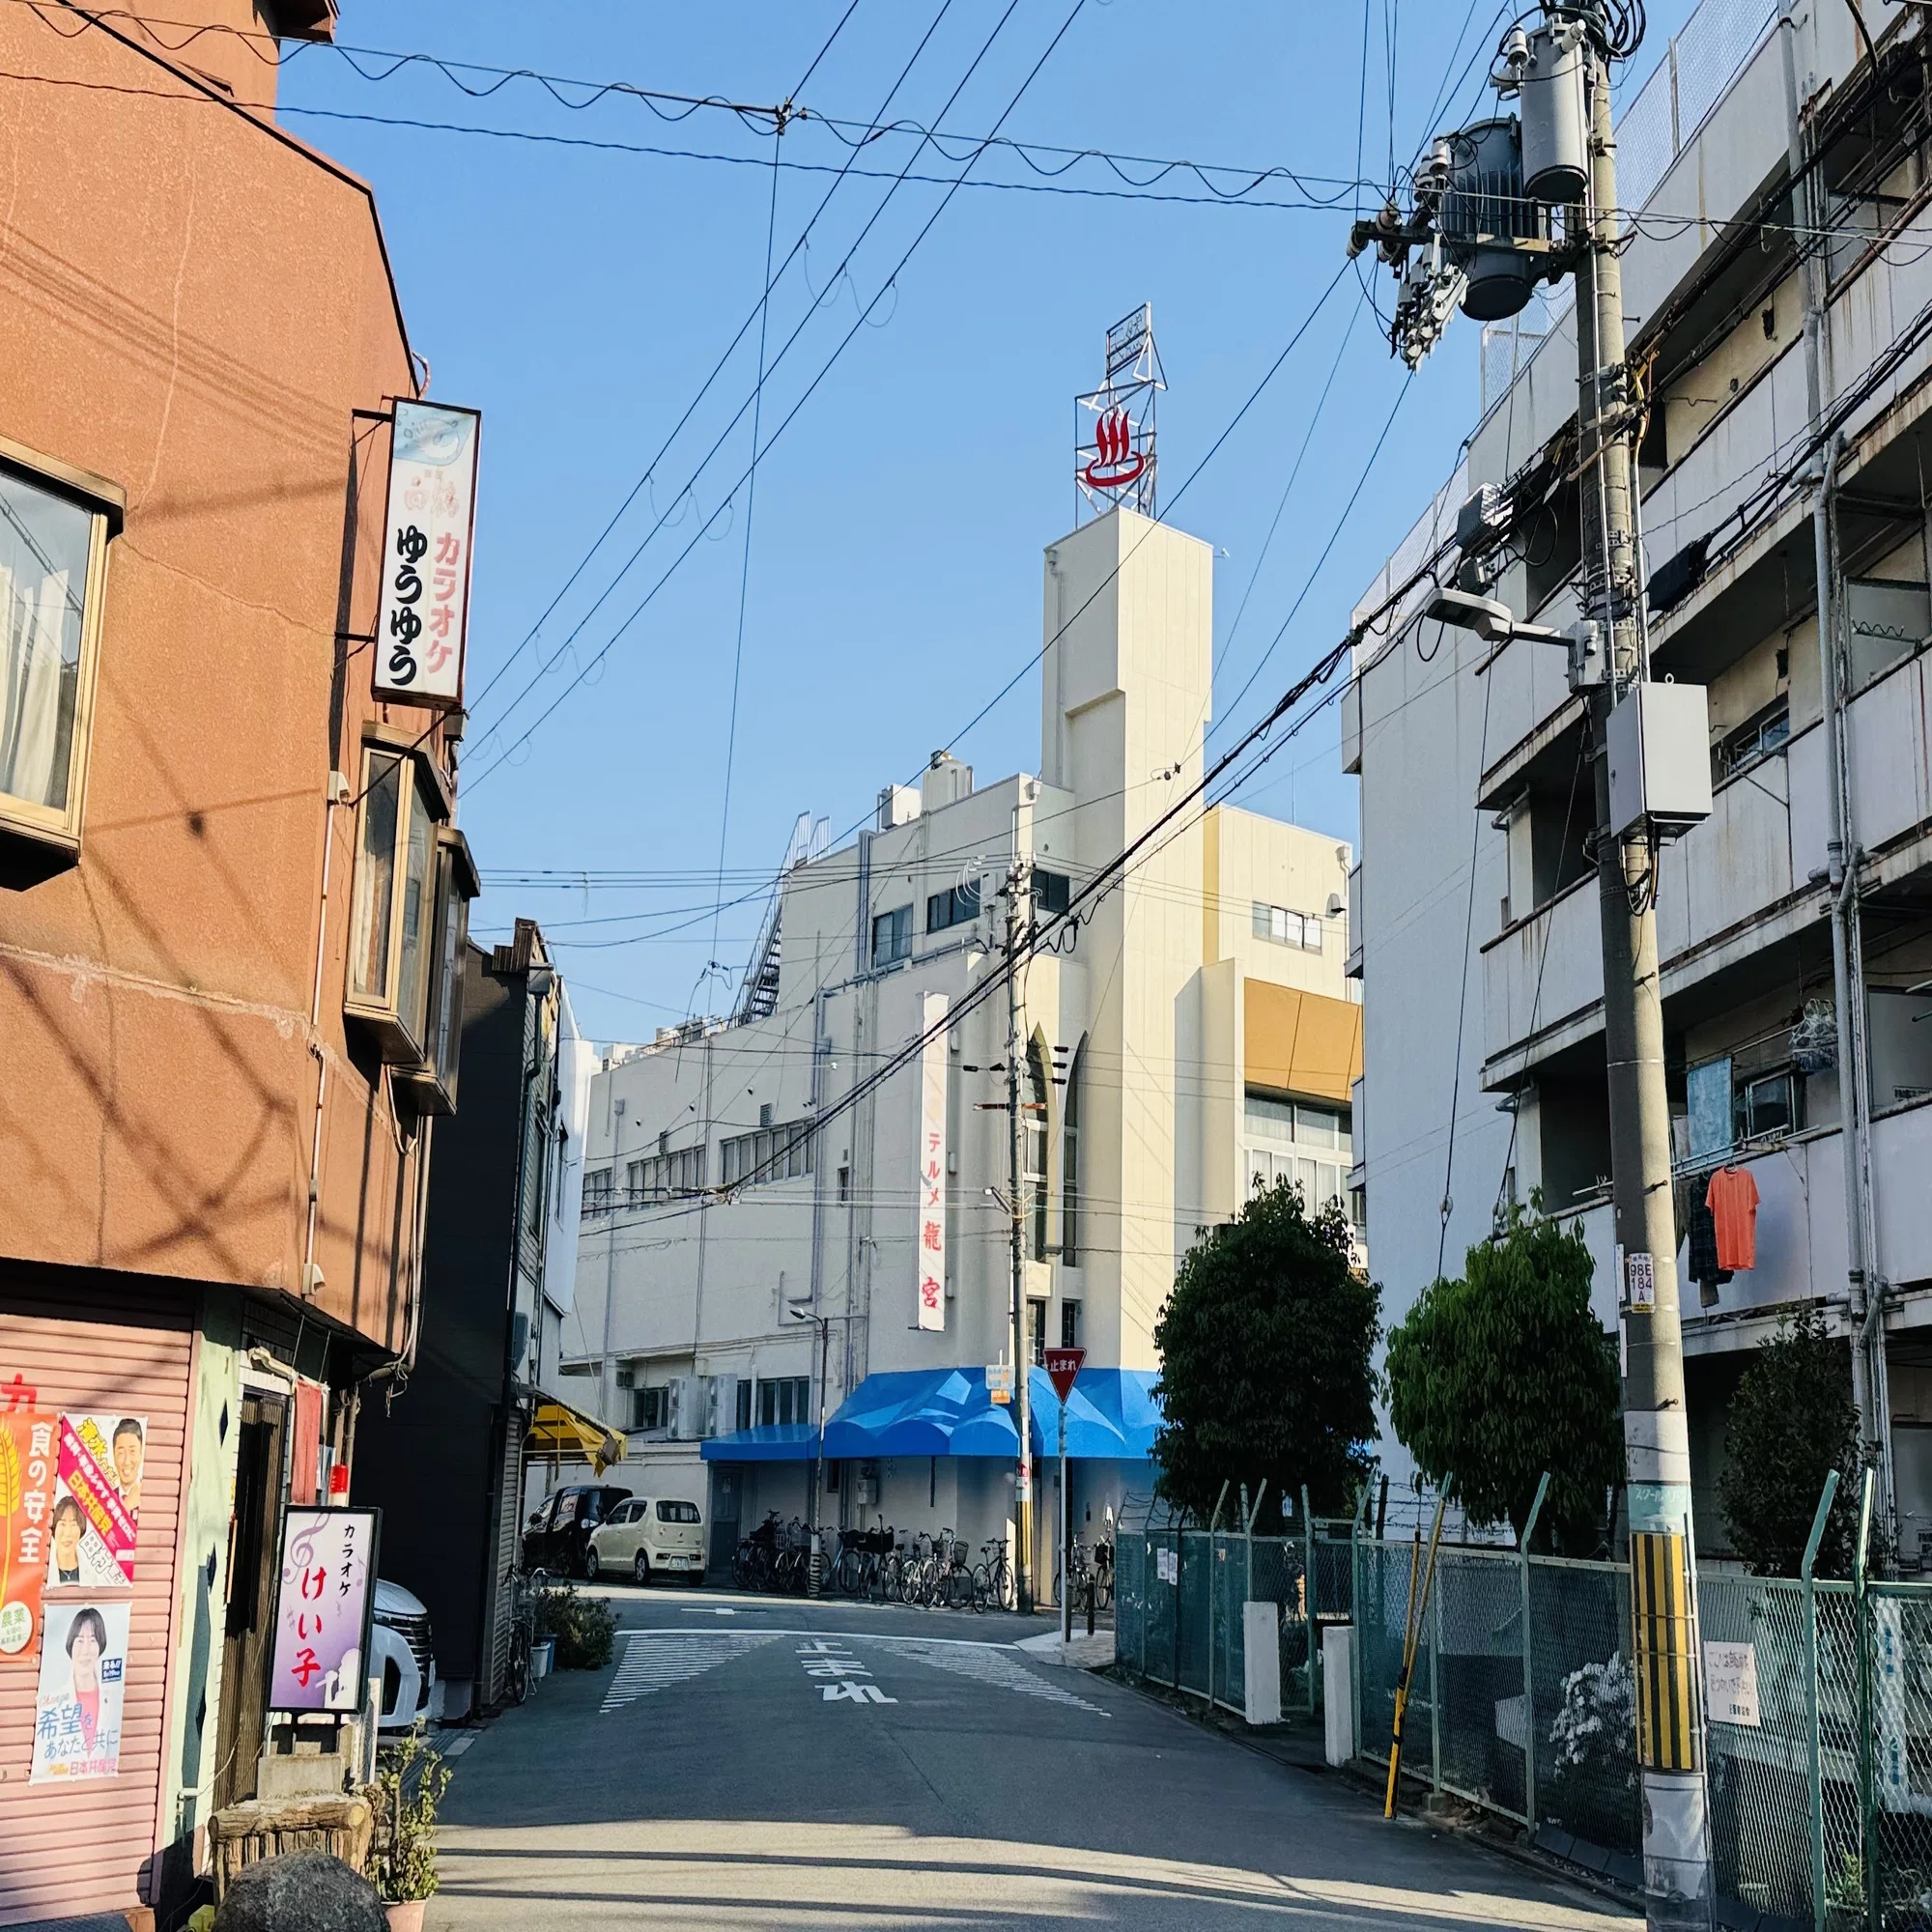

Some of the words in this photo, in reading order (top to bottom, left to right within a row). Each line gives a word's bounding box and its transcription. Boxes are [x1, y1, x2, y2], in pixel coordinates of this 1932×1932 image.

[388, 525, 427, 686] ゆうゆう
[425, 532, 460, 673] カラオケ
[922, 1132, 942, 1309] テルメ龍宮
[1630, 1264, 1652, 1277] 98E
[1631, 1277, 1653, 1291] 184
[1637, 1290, 1646, 1303] A
[1050, 1359, 1077, 1372] 止まれ
[18, 1421, 54, 1563] 食の安全
[68, 1468, 113, 1537] 日本共産党
[339, 1524, 355, 1597] カラオケ
[291, 1566, 327, 1688] けい子
[795, 1638, 899, 1704] 止まれ
[37, 1703, 94, 1739] 希望を
[44, 1729, 118, 1759] あなたと共に
[70, 1758, 117, 1776] 日本共産党
